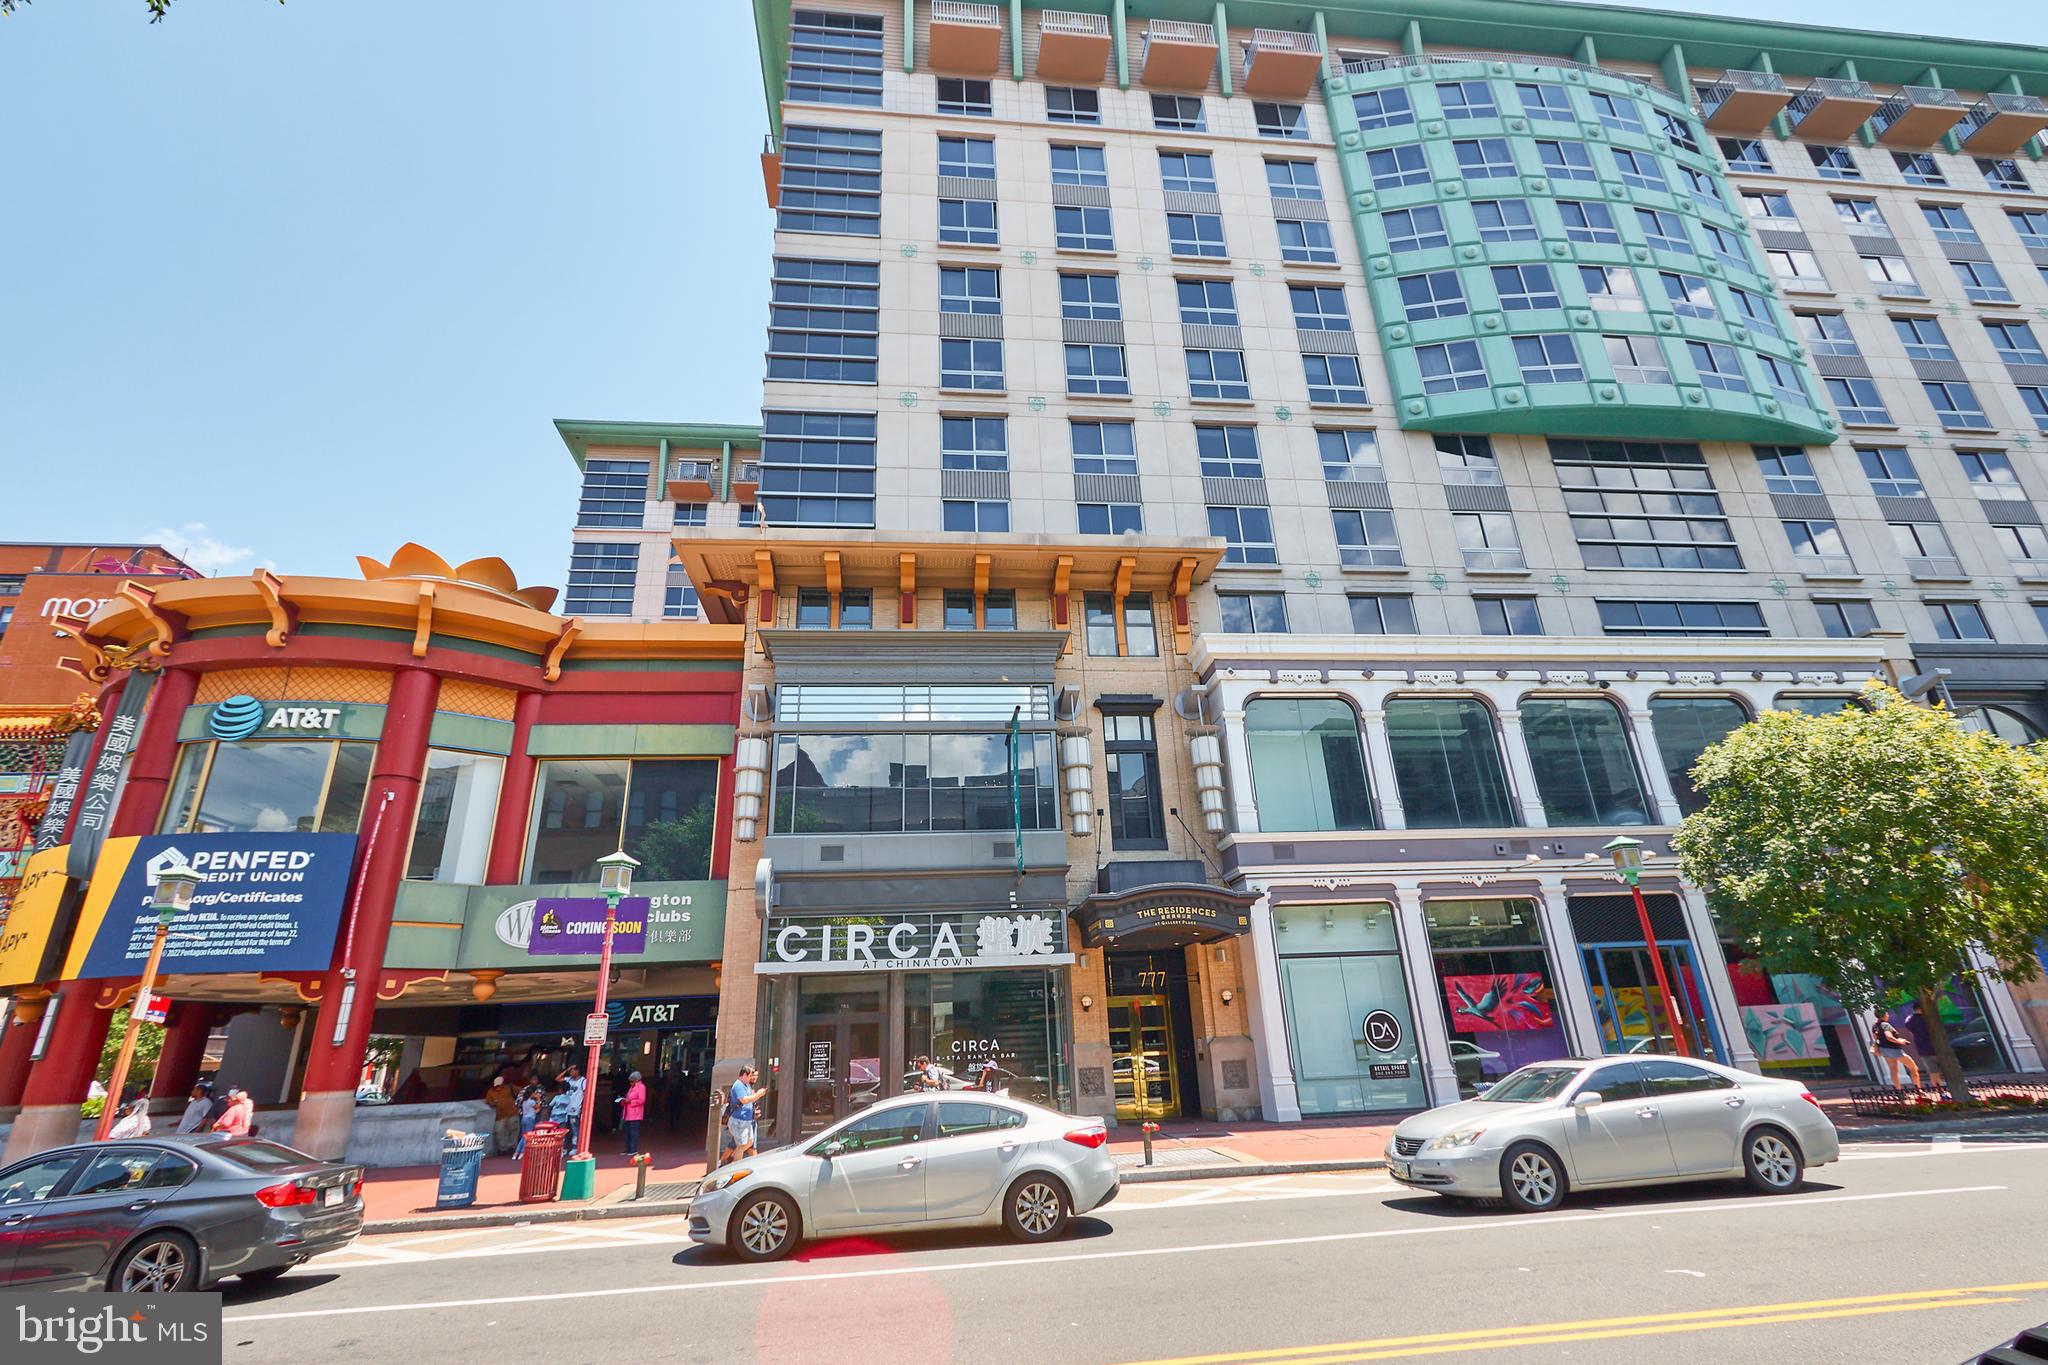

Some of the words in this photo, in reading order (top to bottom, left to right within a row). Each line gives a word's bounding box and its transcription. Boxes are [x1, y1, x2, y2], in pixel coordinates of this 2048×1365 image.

[266, 707, 340, 729] AT&T
[82, 715, 136, 831] 美國娛樂公司
[191, 851, 310, 870] PENFED
[250, 872, 304, 882] UNION
[189, 913, 199, 923] by
[1136, 908, 1156, 919] THE
[1157, 906, 1217, 918] RESIDENCES
[612, 921, 642, 934] SOON
[165, 941, 185, 949] subject
[192, 940, 212, 948] change
[776, 922, 963, 962] CIRCA
[180, 948, 207, 957] Pentagon
[207, 948, 229, 956] Federal
[229, 947, 246, 955] Credit
[246, 947, 265, 955] Union.
[862, 960, 879, 969] AT
[886, 957, 974, 968] CHINATOWN
[1137, 971, 1166, 988] 777
[629, 1004, 680, 1023] AT&T
[951, 1039, 1000, 1053] CIRCA
